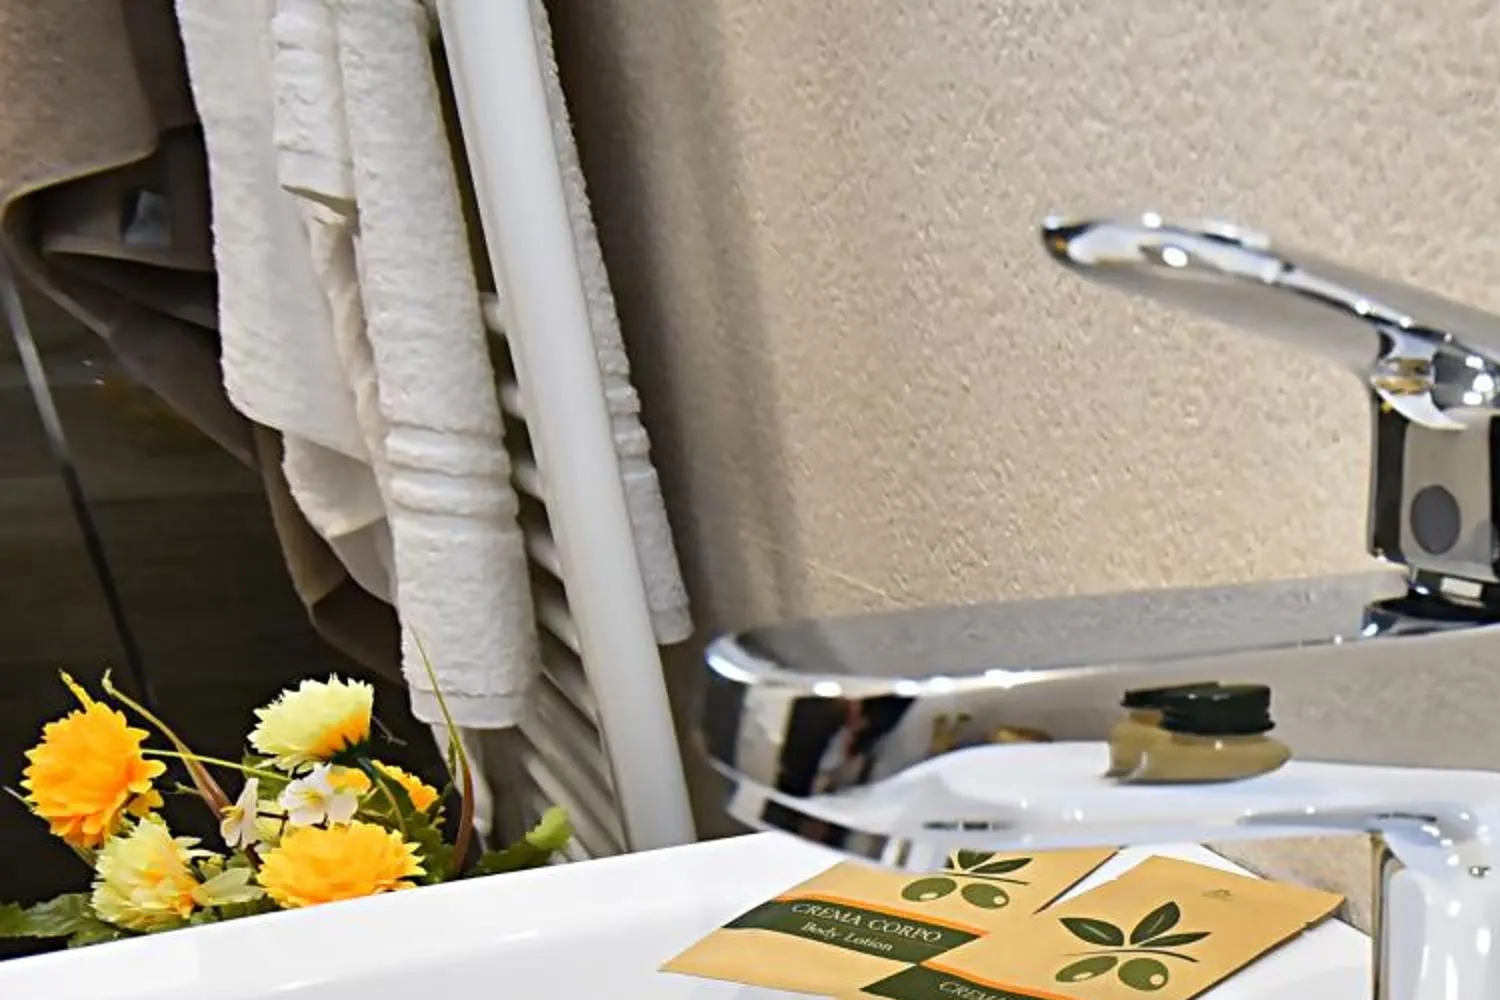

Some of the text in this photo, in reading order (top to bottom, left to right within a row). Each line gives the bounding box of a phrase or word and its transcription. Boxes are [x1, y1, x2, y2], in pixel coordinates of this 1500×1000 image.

[790, 902, 943, 943] CREMA CORPO
[843, 931, 894, 952] Lotion
